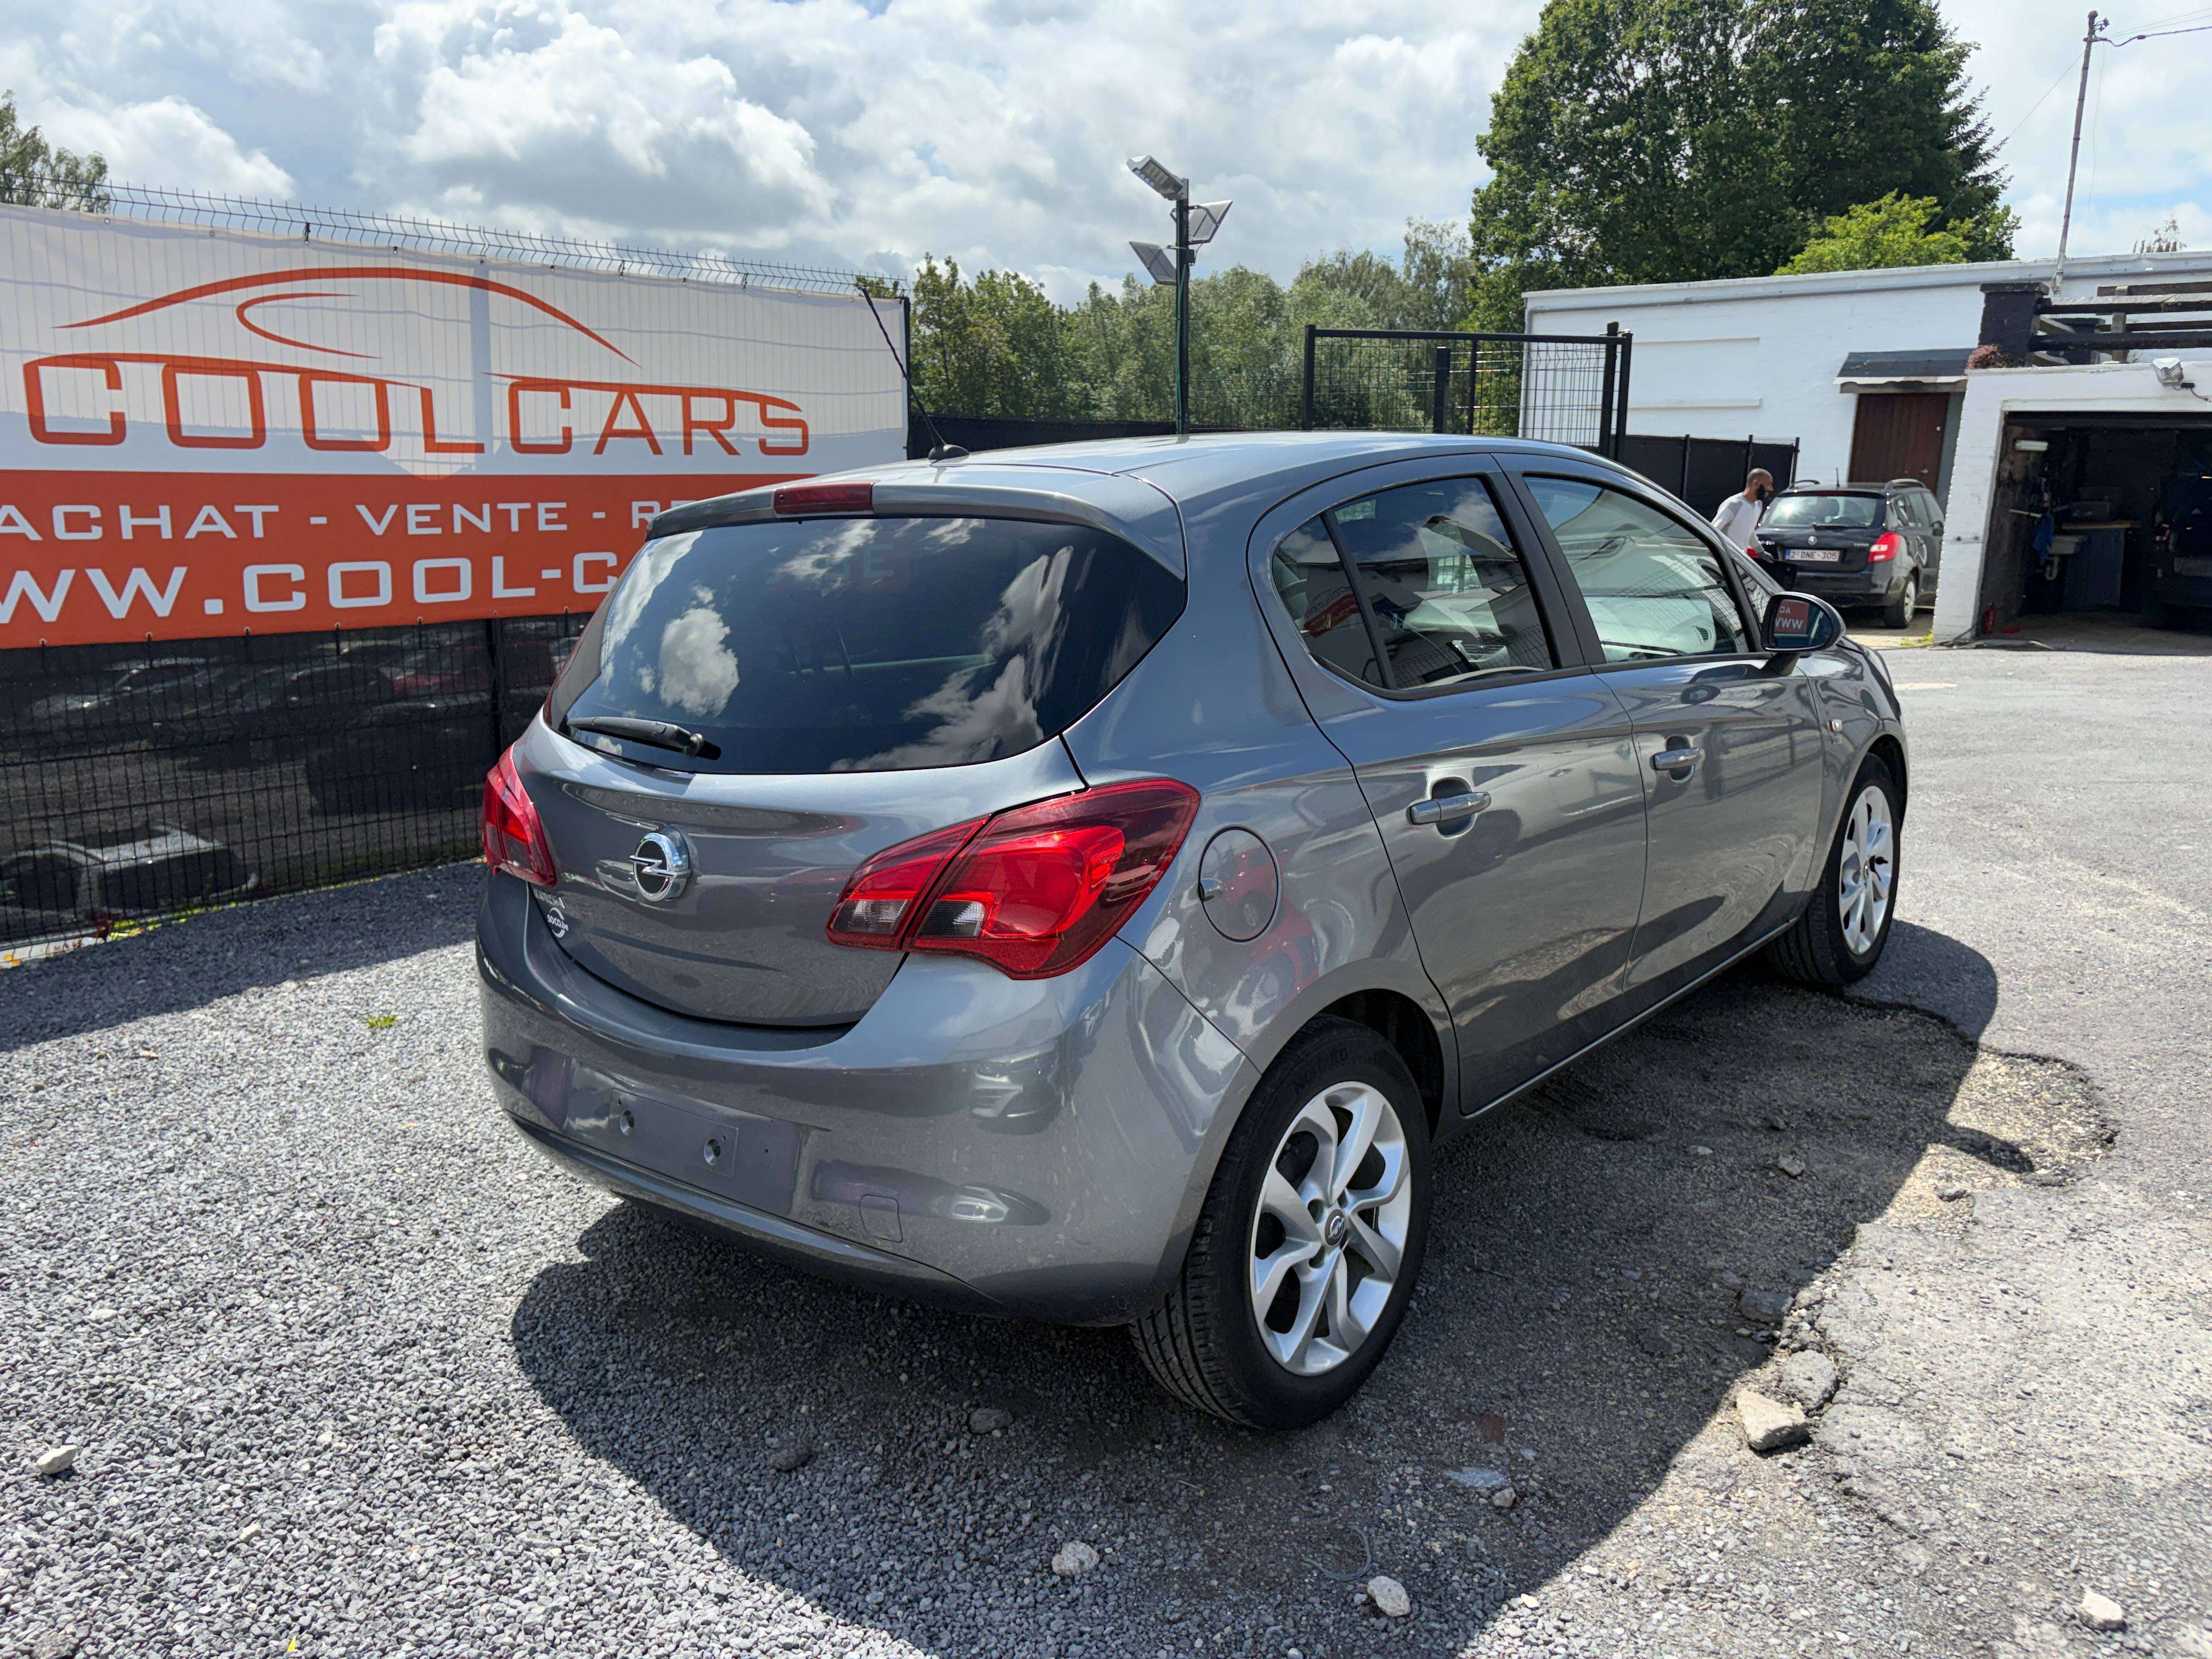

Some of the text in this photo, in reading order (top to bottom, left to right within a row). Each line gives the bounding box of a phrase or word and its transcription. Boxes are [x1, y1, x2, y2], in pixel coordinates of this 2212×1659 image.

[23, 352, 809, 456] COOL CARS
[0, 505, 279, 541] ACHAT
[356, 501, 568, 536] VENTE
